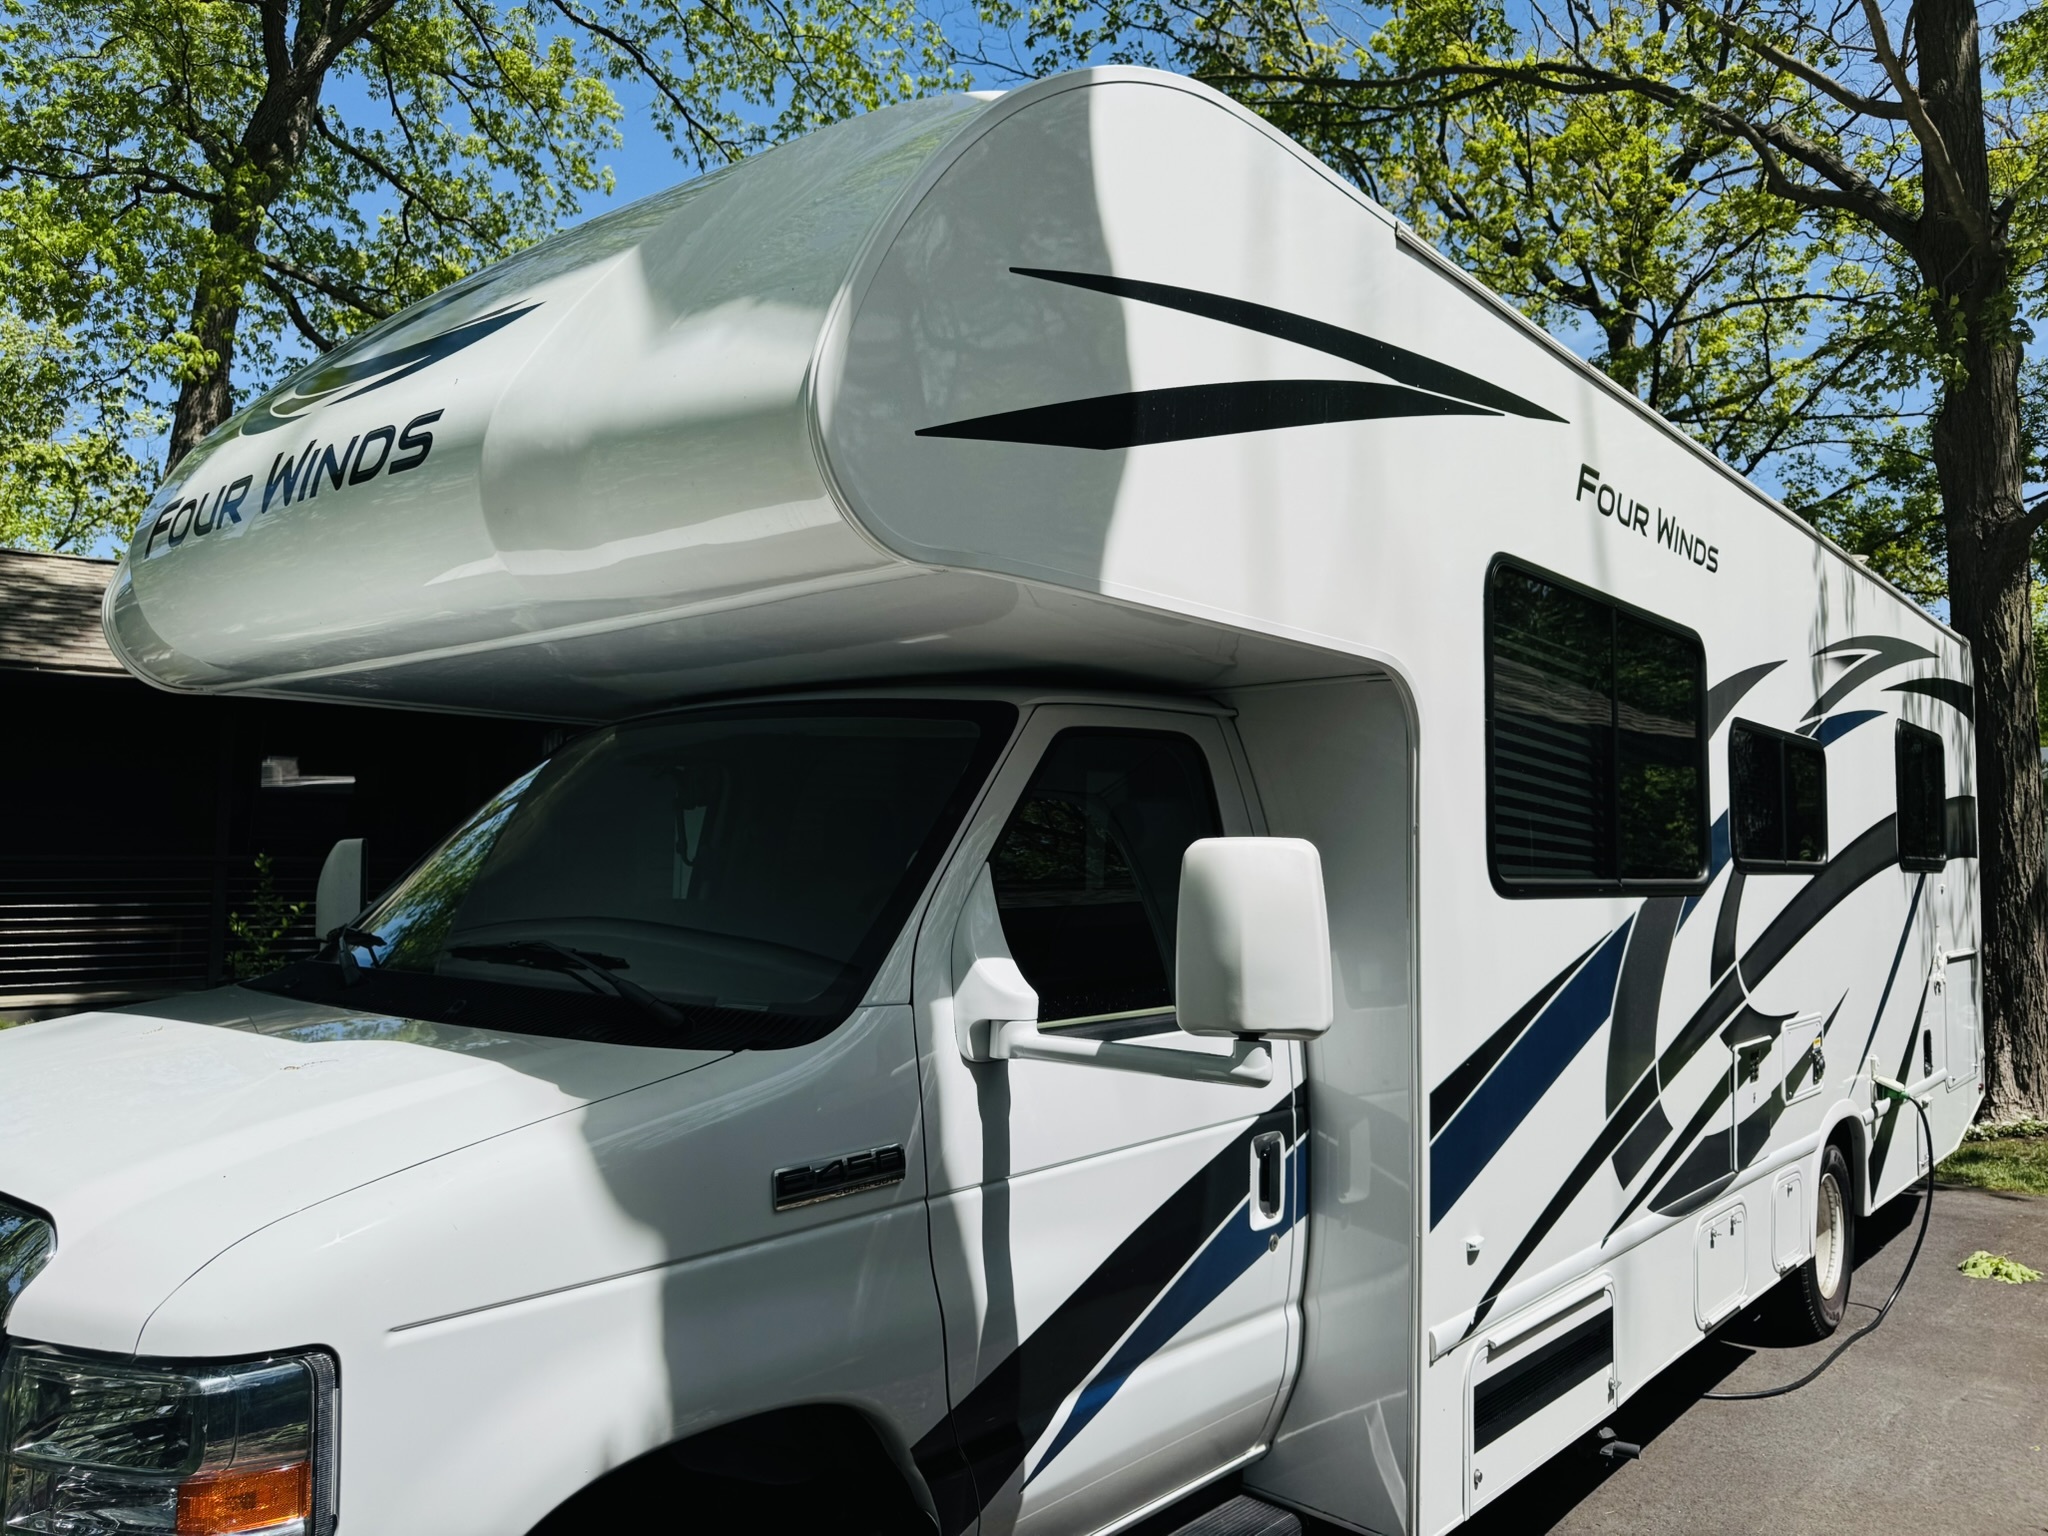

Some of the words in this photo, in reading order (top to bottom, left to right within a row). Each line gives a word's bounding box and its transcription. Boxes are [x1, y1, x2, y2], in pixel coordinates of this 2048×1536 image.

[144, 474, 254, 560] FOUR
[260, 408, 446, 514] WINDS
[1575, 462, 1650, 538] FOUR
[1657, 506, 1720, 574] WINDS
